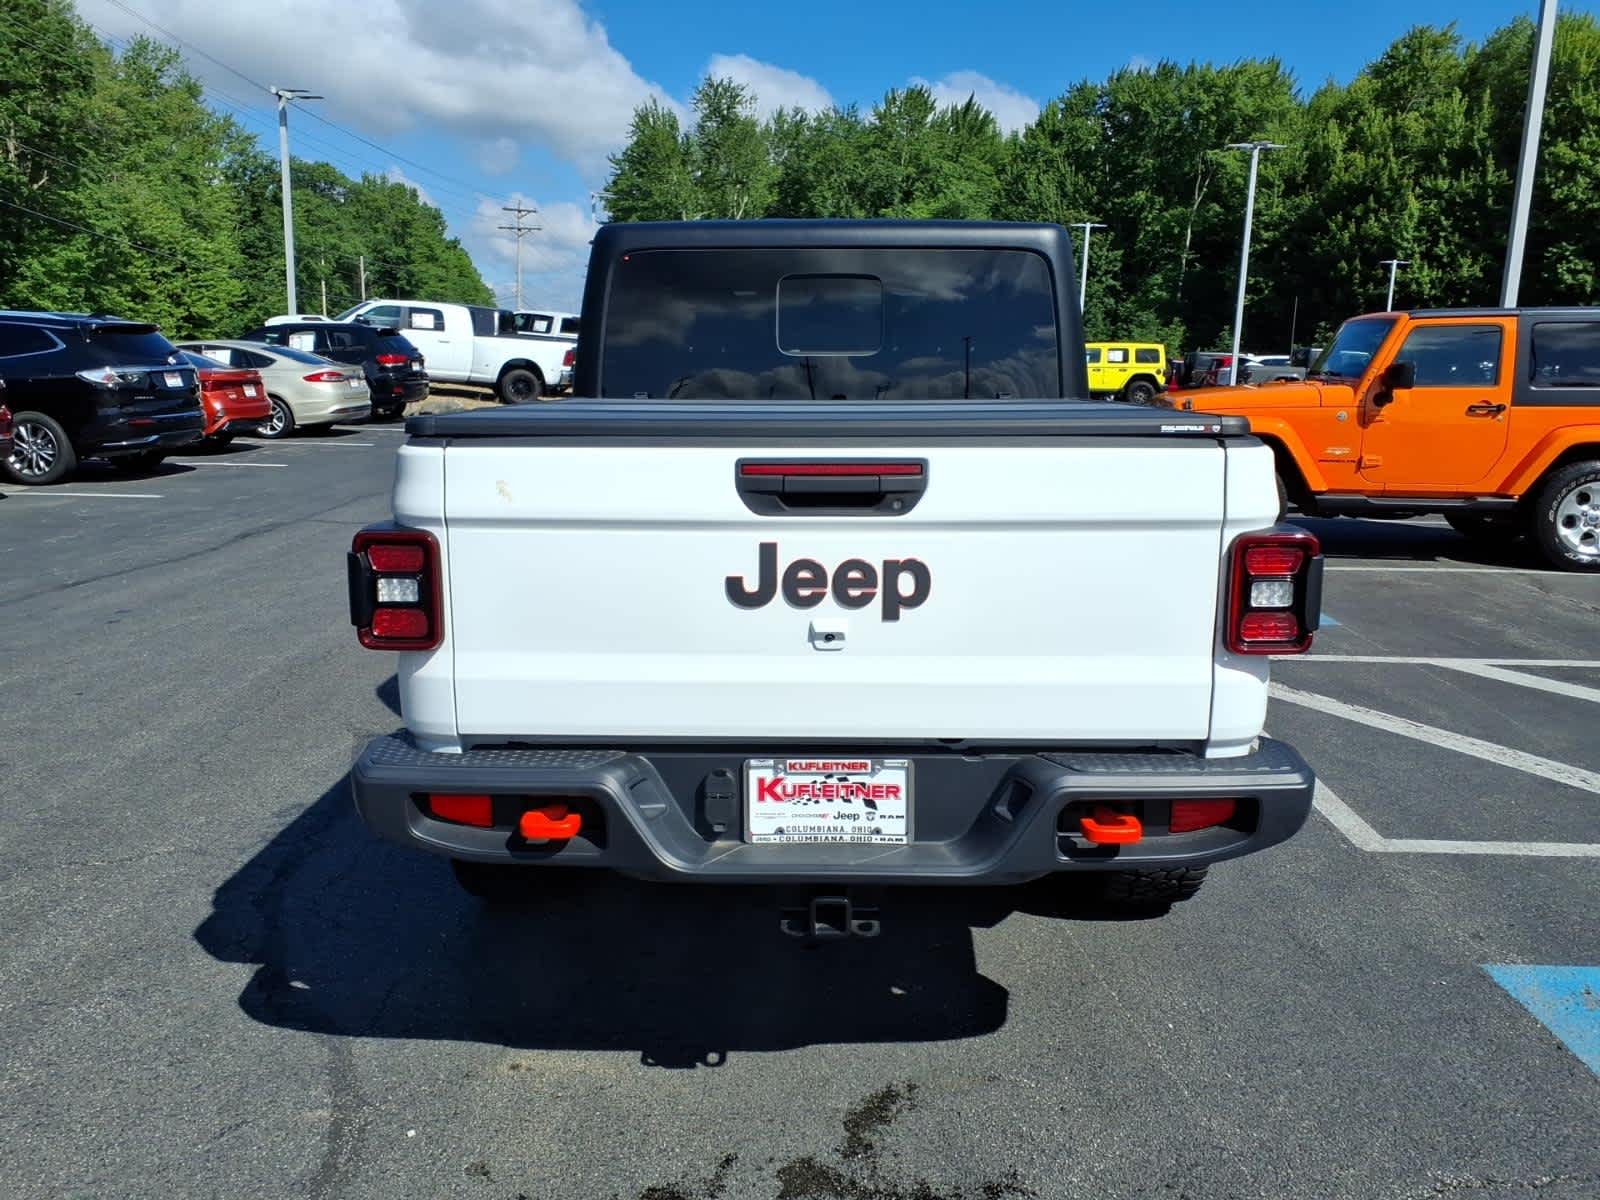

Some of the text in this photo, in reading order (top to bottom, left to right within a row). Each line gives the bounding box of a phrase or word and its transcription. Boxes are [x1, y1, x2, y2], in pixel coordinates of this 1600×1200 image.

[725, 542, 931, 622] Jeep
[788, 761, 869, 771] KUFLEITNER
[757, 776, 902, 803] KUFLEITNER
[833, 811, 860, 822] Jeep
[851, 825, 872, 833] OHIO
